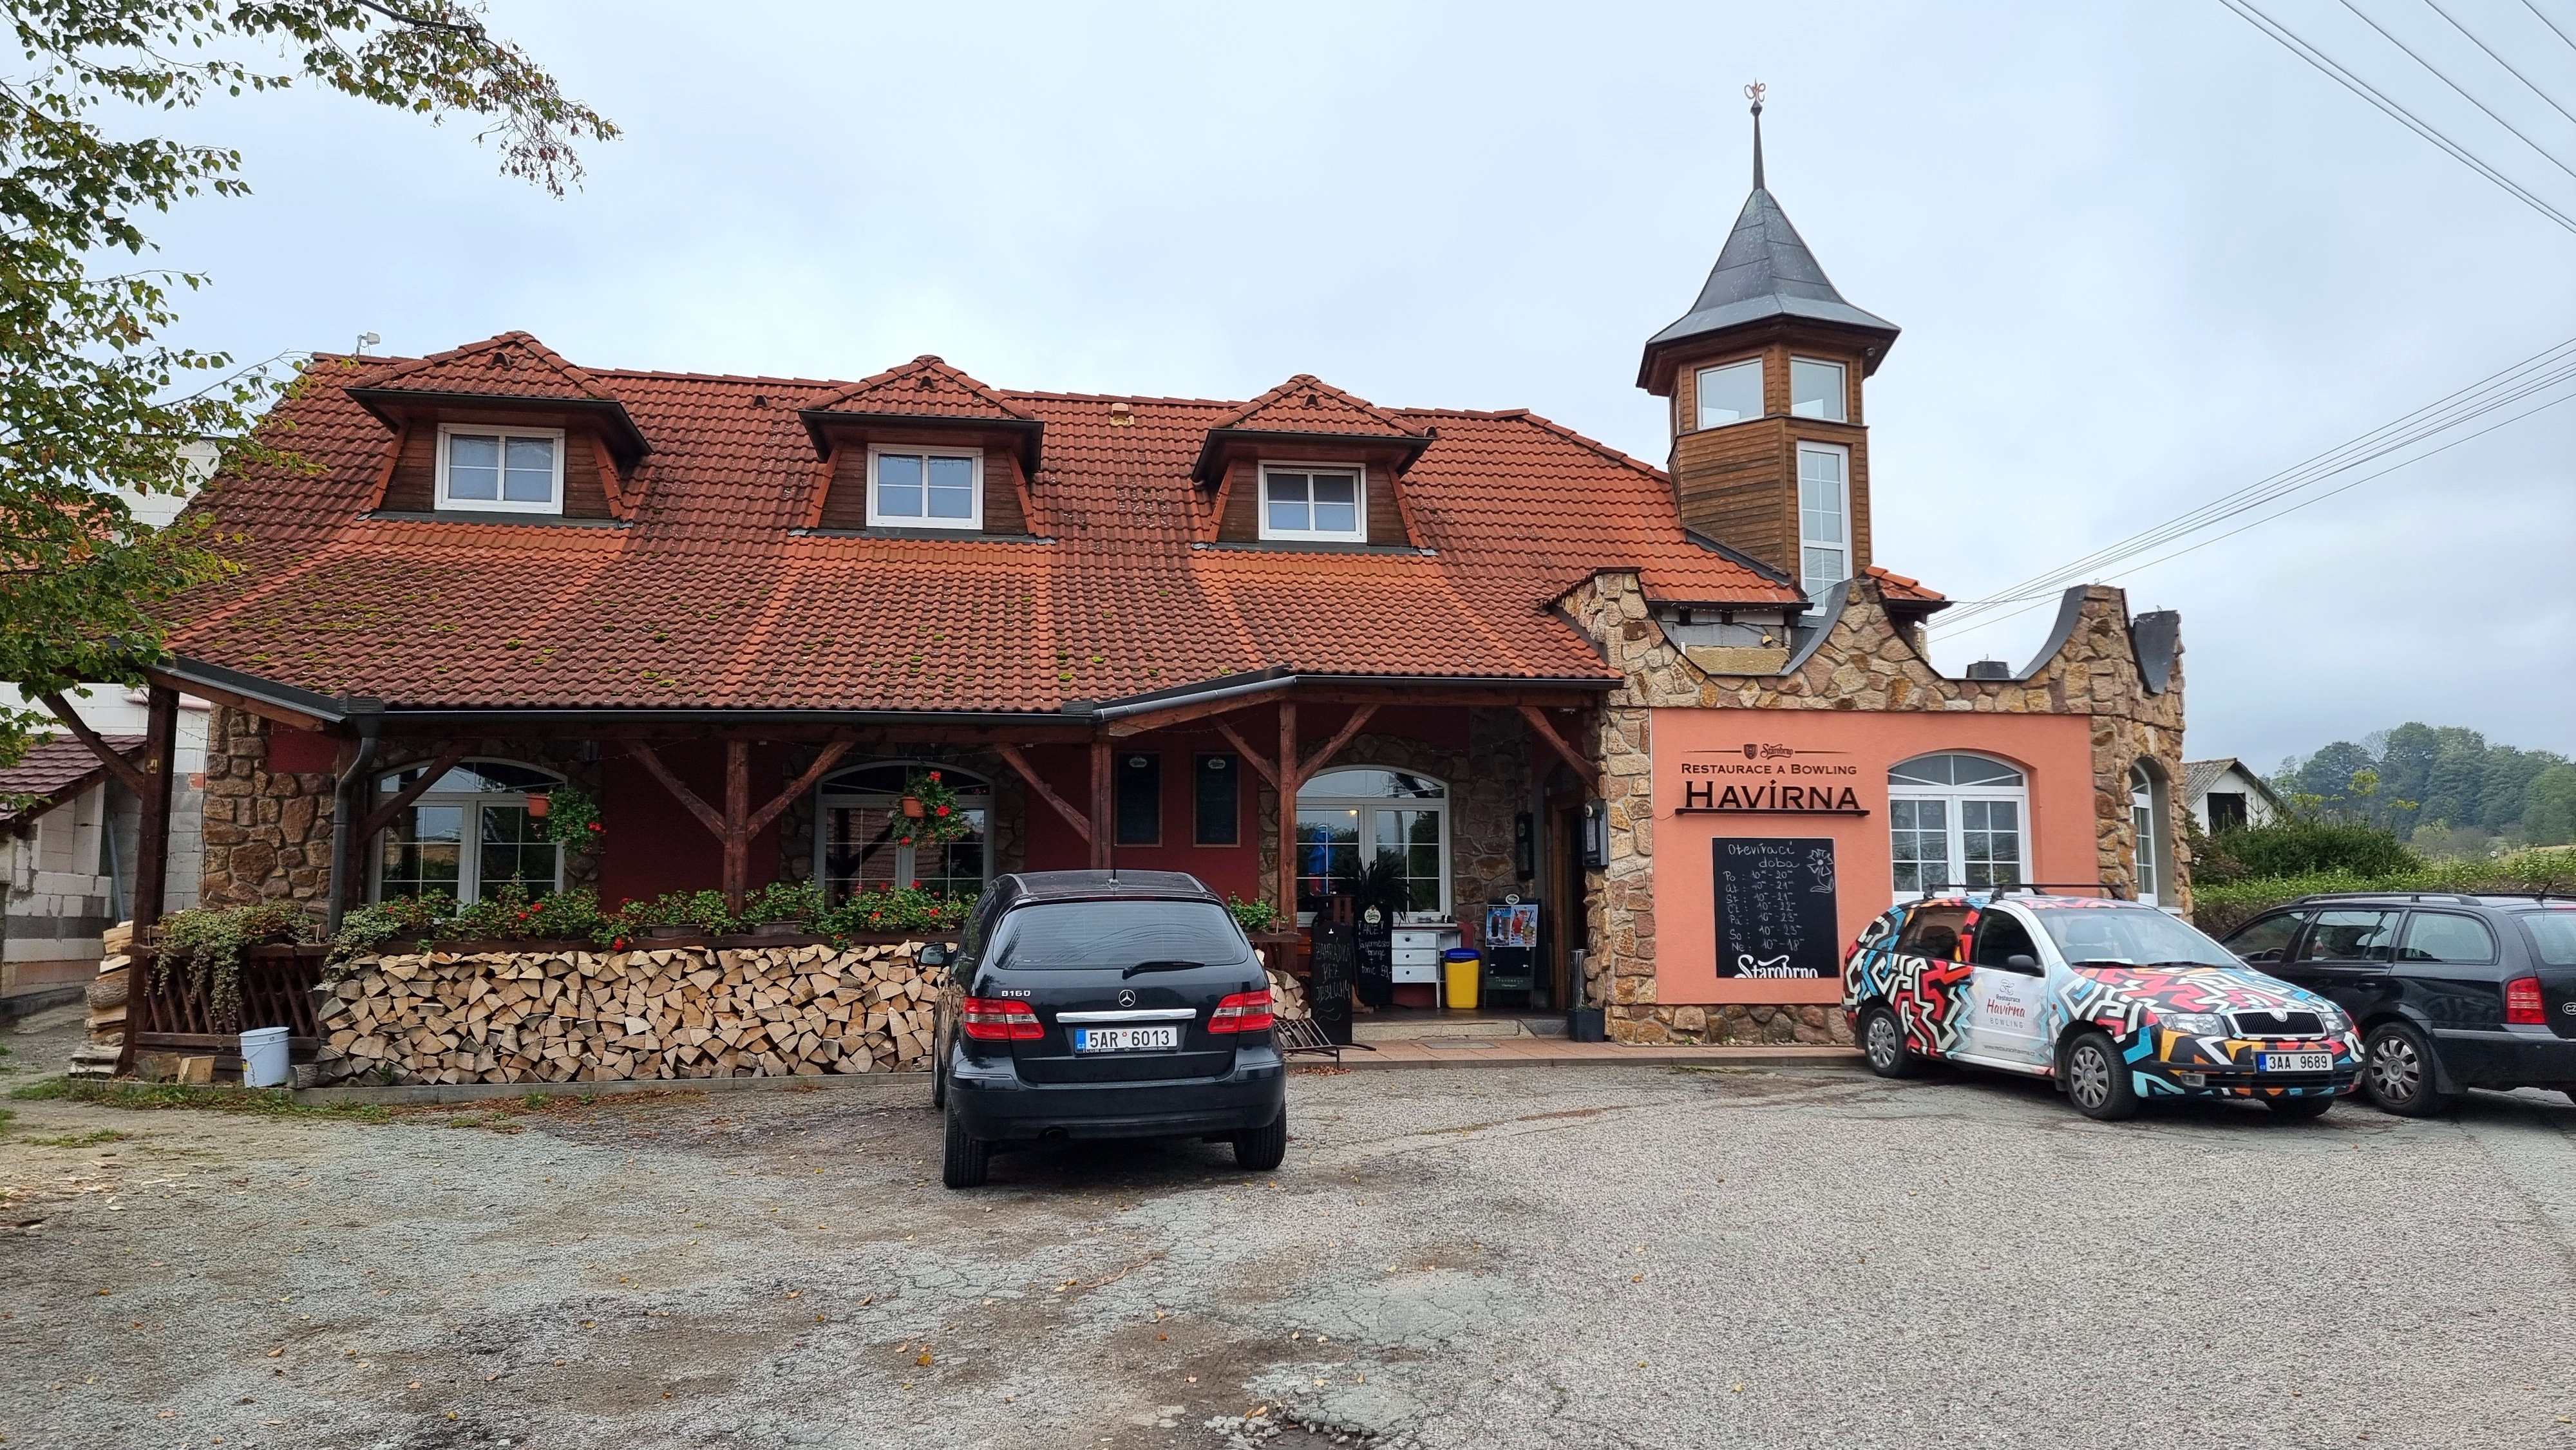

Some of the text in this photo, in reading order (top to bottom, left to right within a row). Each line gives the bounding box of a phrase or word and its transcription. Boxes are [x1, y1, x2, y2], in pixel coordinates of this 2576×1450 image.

[1681, 764, 1857, 775] RESTAURACE A BOWLING
[1685, 779, 1861, 809] HAVÍRNA
[1728, 841, 1795, 855] Otevírací
[1759, 856, 1800, 868] doba
[1986, 998, 2026, 1018] Havírna
[1990, 1017, 2023, 1028] BOWLING
[1090, 1030, 1170, 1048] 5AR 6013
[2269, 1055, 2327, 1069] 3AA 9689
